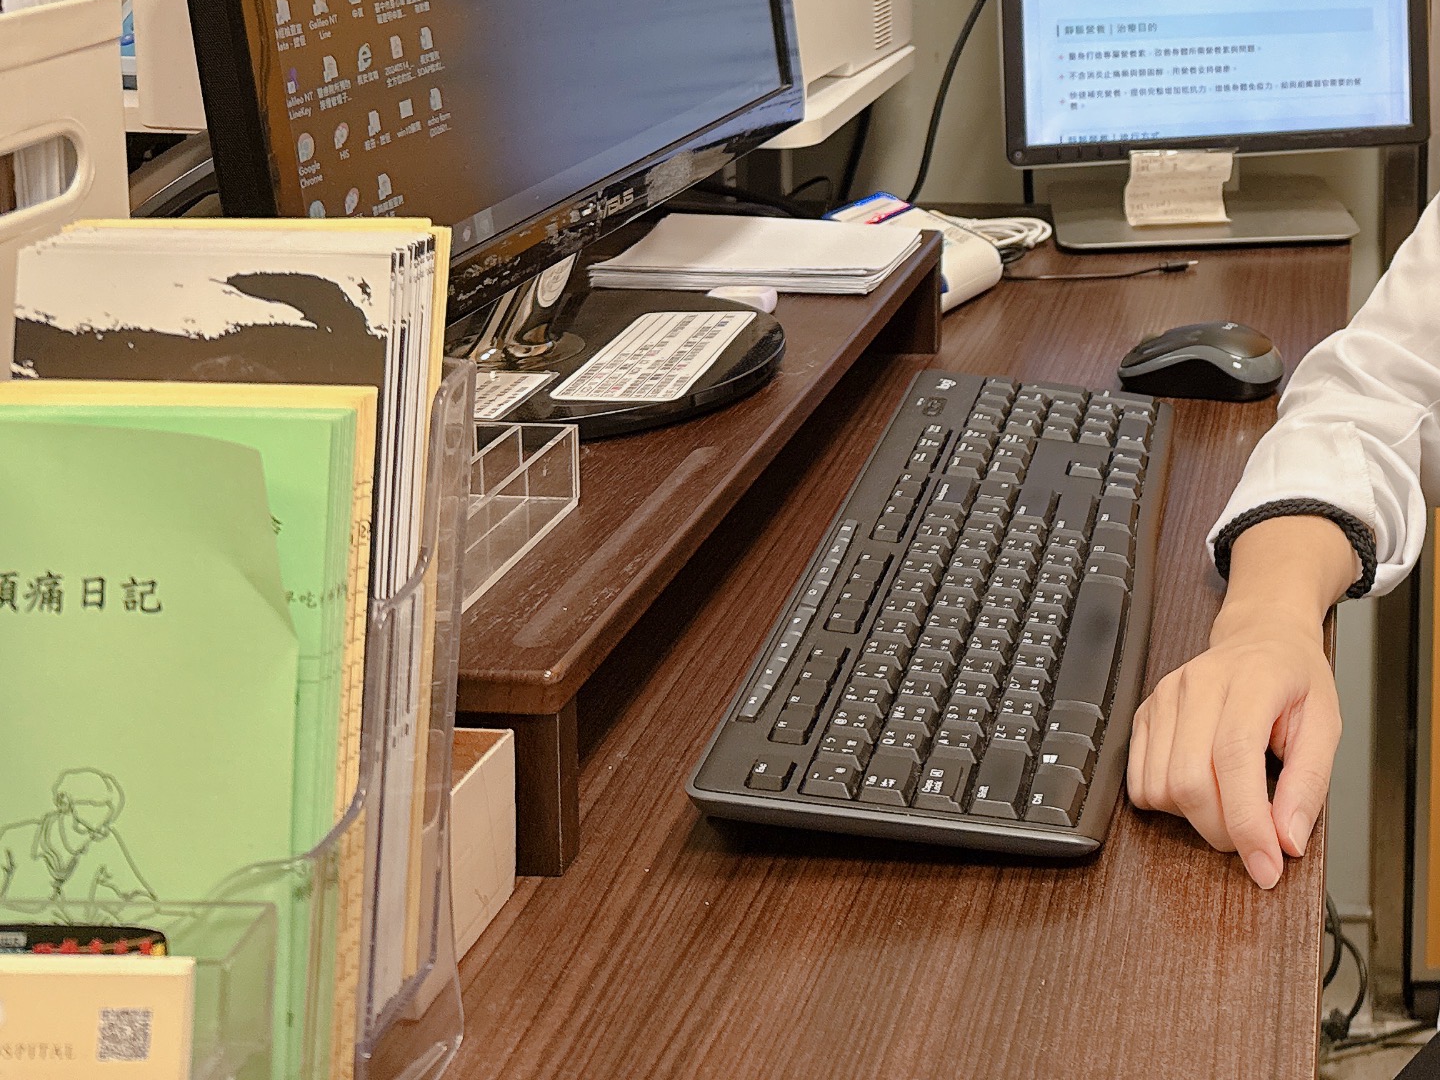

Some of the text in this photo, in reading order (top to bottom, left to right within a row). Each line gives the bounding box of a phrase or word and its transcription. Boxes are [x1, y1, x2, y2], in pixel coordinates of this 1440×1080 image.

[299, 160, 321, 176] Google
[300, 174, 323, 189] Chrome
[600, 189, 634, 218] ASUS
